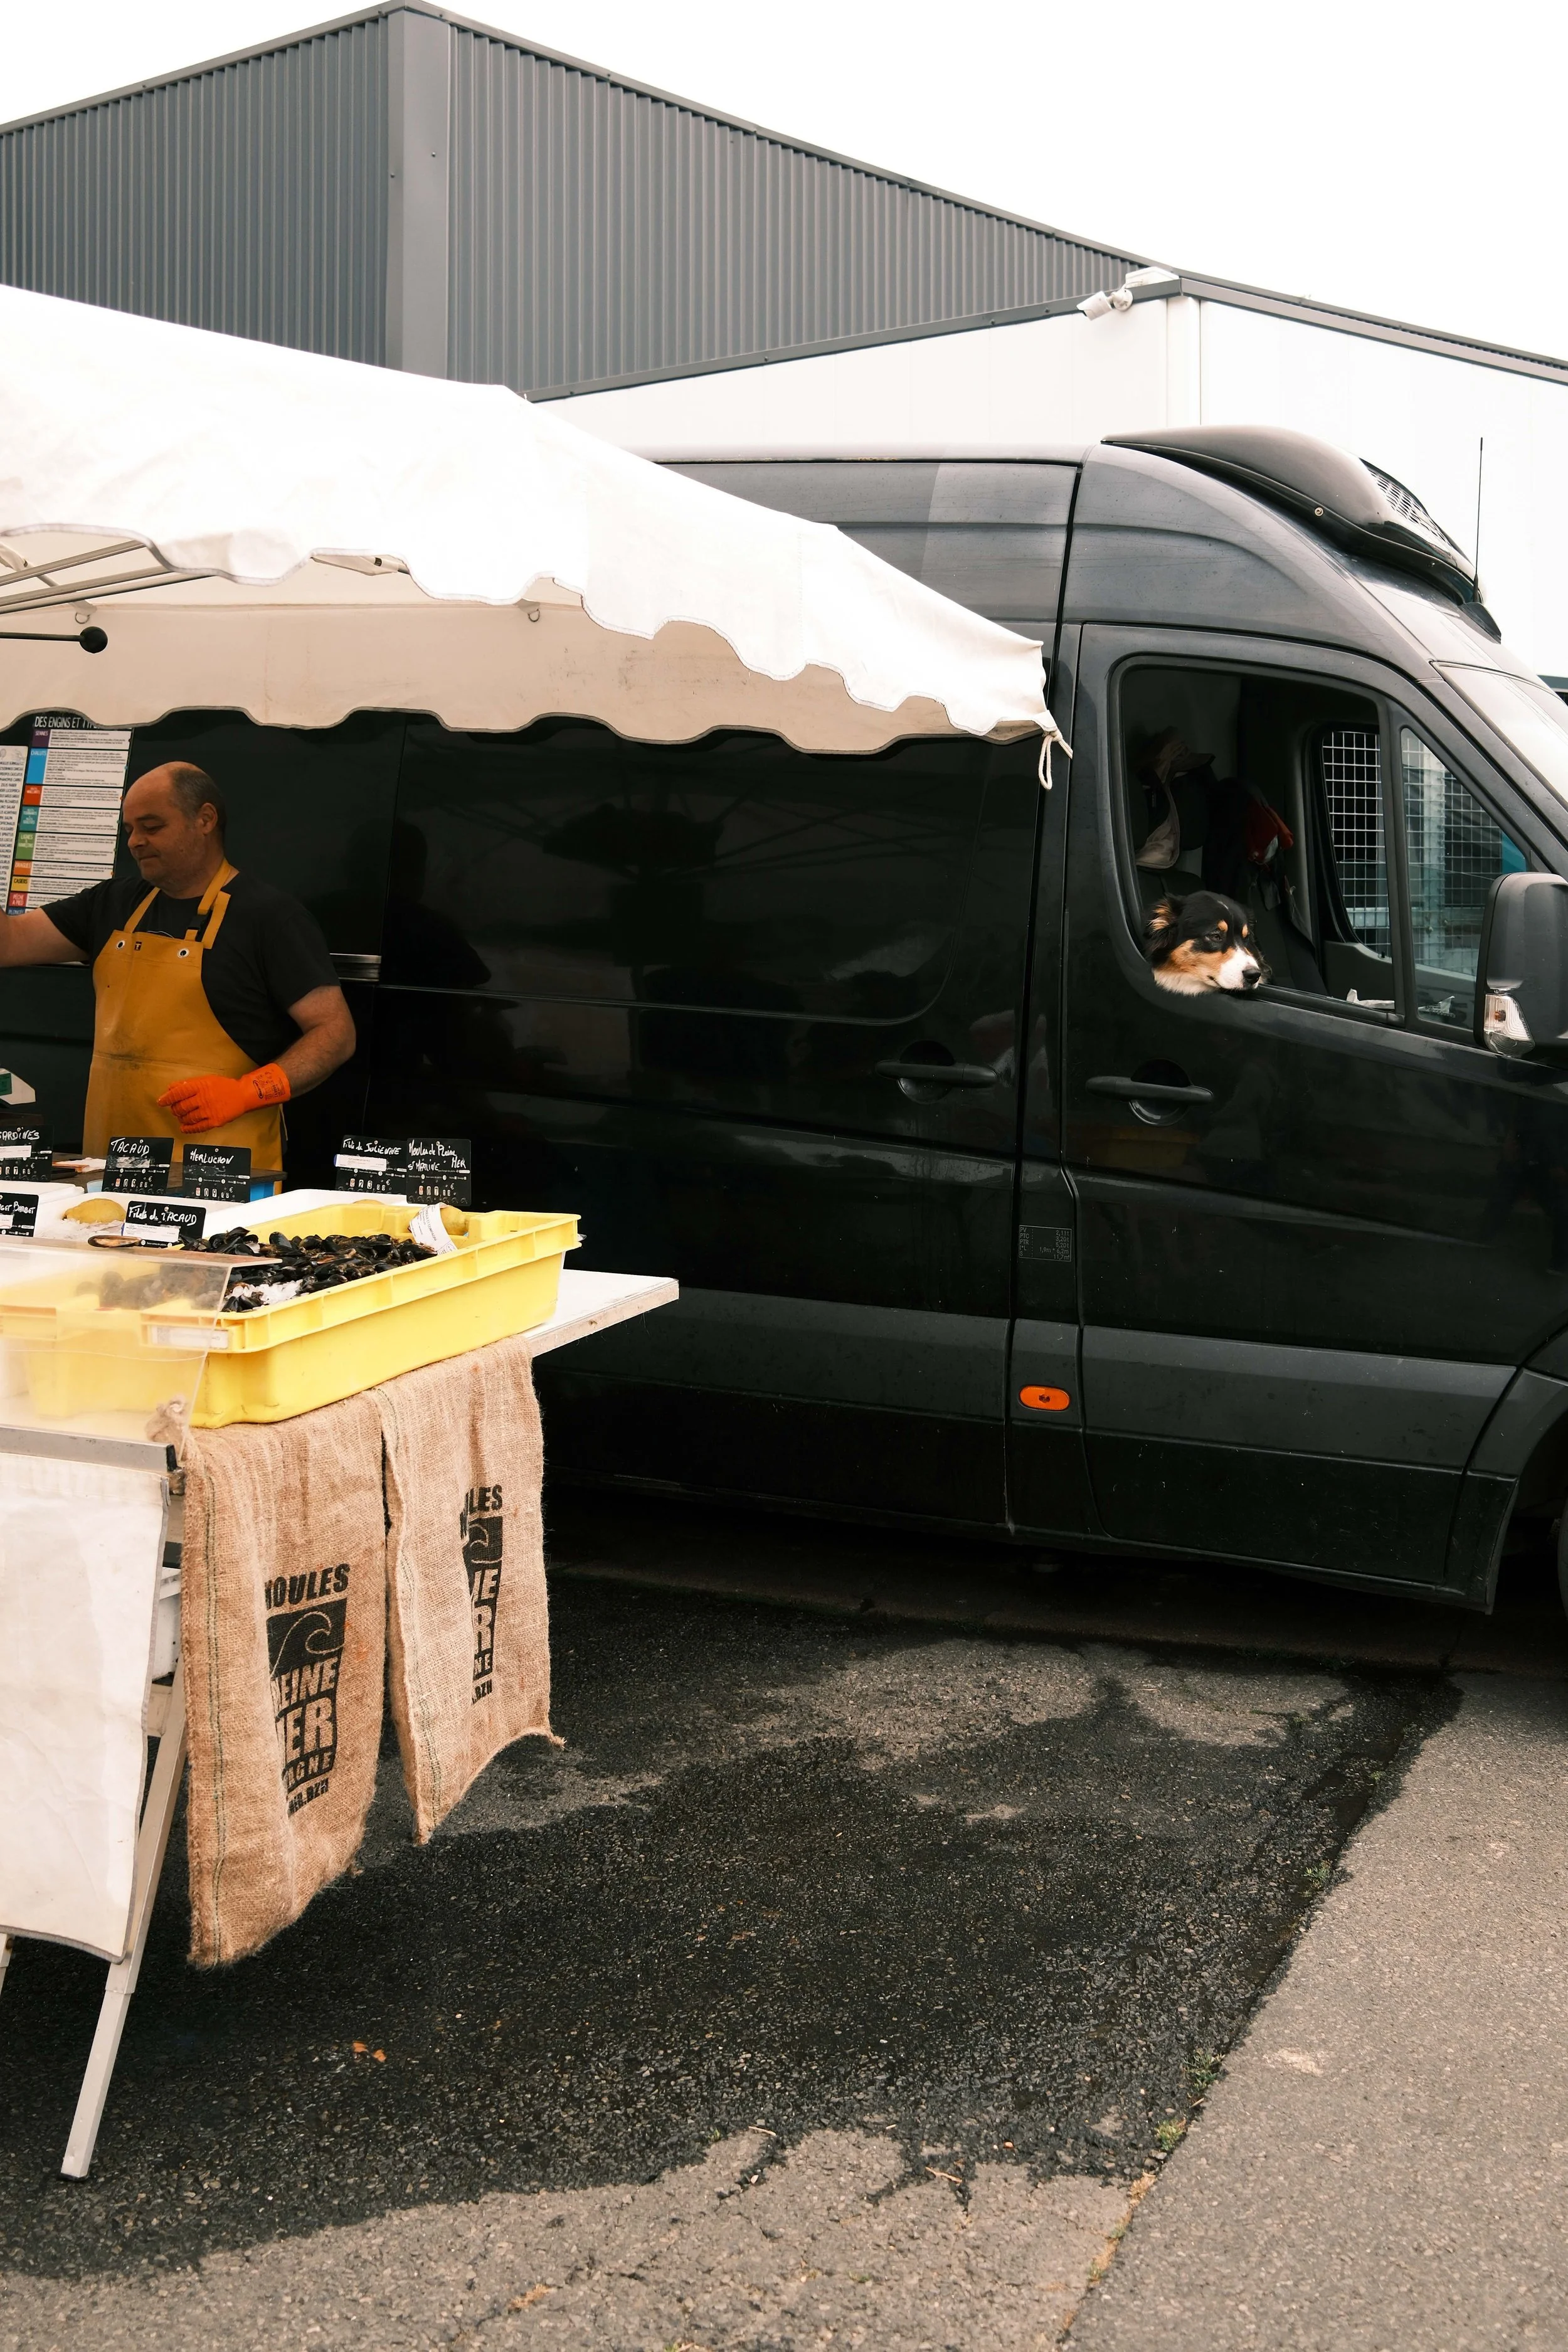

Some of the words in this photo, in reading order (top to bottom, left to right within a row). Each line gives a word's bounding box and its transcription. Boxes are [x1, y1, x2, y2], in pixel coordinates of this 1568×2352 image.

[34, 716, 47, 728] DES
[48, 716, 71, 728] ENGINS
[72, 717, 81, 728] ET
[110, 1138, 149, 1157] TACAUD
[276, 1656, 339, 1707] EINE
[280, 1697, 334, 1761] ER
